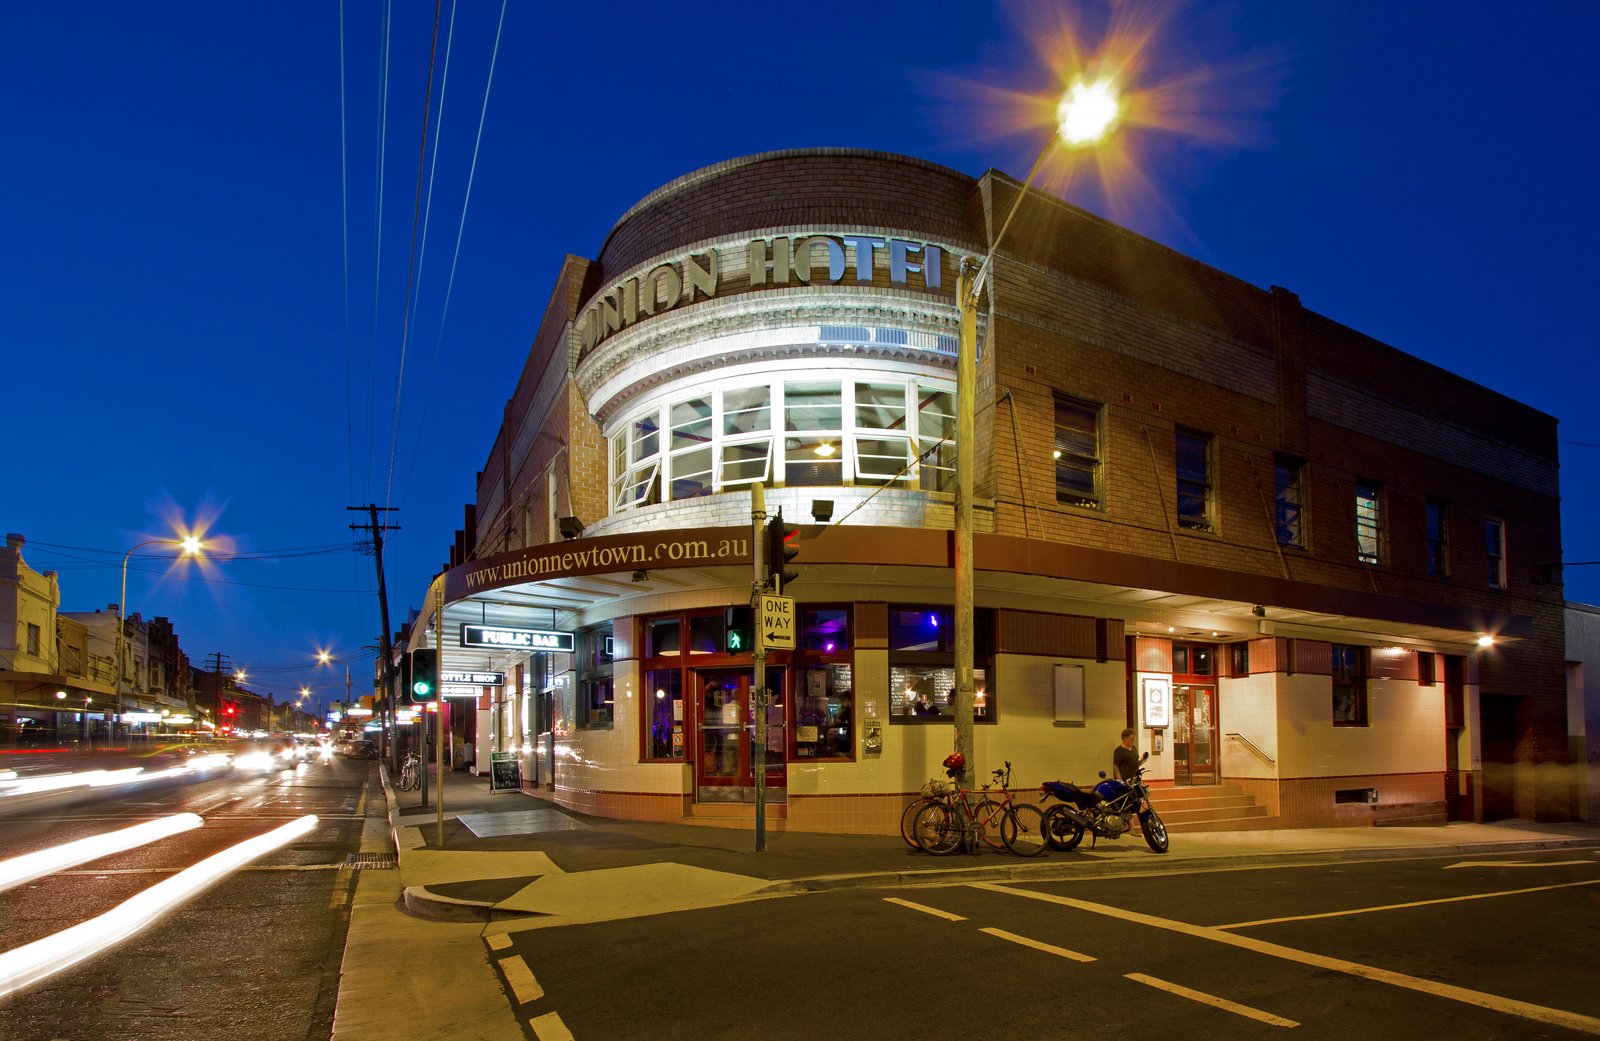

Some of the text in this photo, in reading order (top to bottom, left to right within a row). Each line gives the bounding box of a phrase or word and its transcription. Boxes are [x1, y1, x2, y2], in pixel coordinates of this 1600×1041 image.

[581, 247, 719, 352] UNION
[465, 538, 748, 589] www.unionnewtown.com.au
[766, 600, 789, 613] ONE
[764, 616, 791, 629] WAY
[482, 630, 559, 647] PUBLIC BAR
[441, 674, 471, 682] OTTLE
